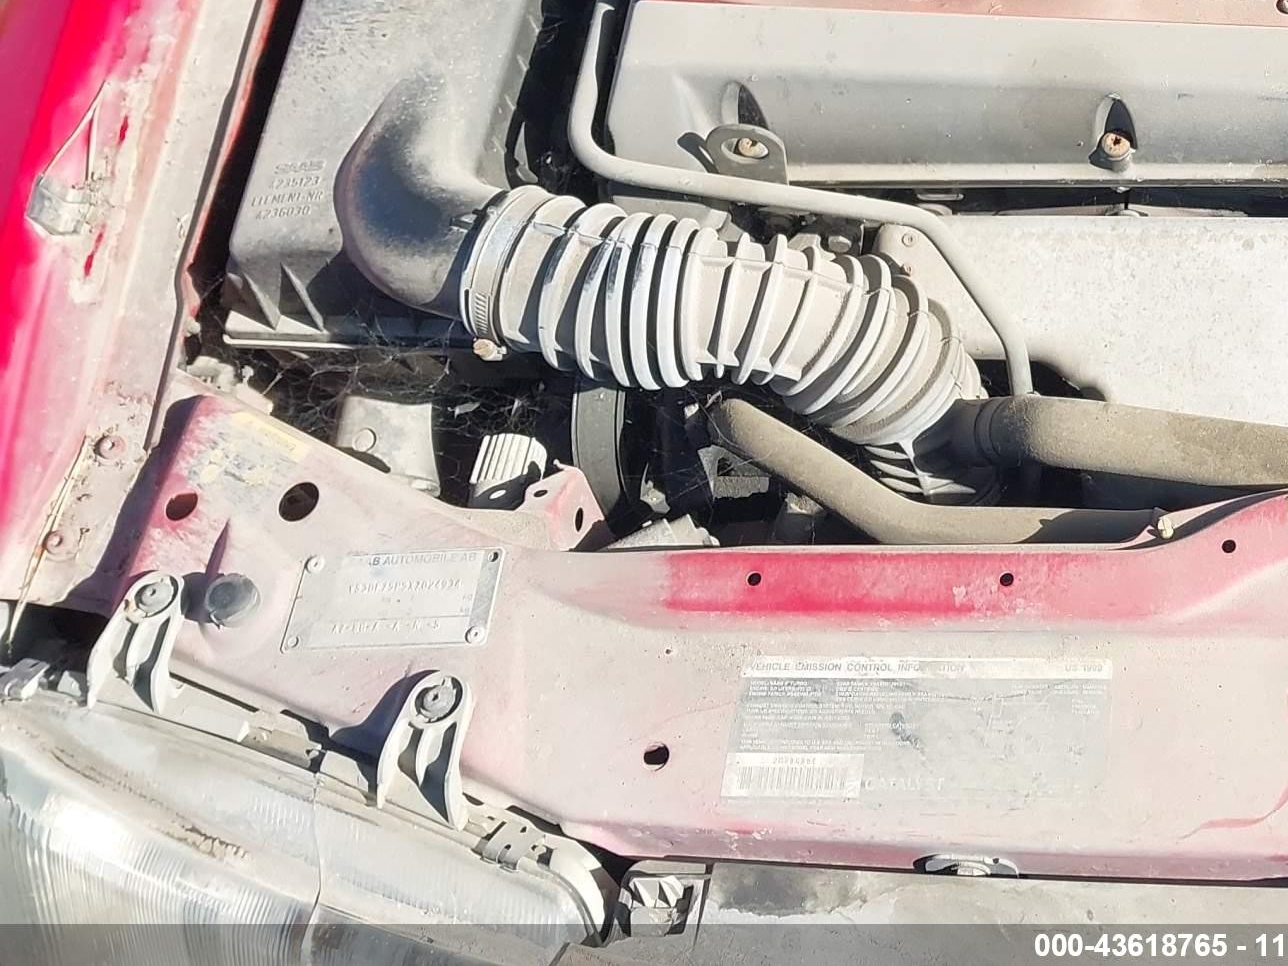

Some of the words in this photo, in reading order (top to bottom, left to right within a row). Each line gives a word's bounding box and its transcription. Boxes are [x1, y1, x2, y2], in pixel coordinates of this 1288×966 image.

[383, 555, 458, 566] AUTOMOBILE
[459, 553, 477, 563] AB
[750, 661, 790, 672] VEHICLE
[795, 661, 842, 672] EMISSION
[847, 661, 893, 673] CONTROL
